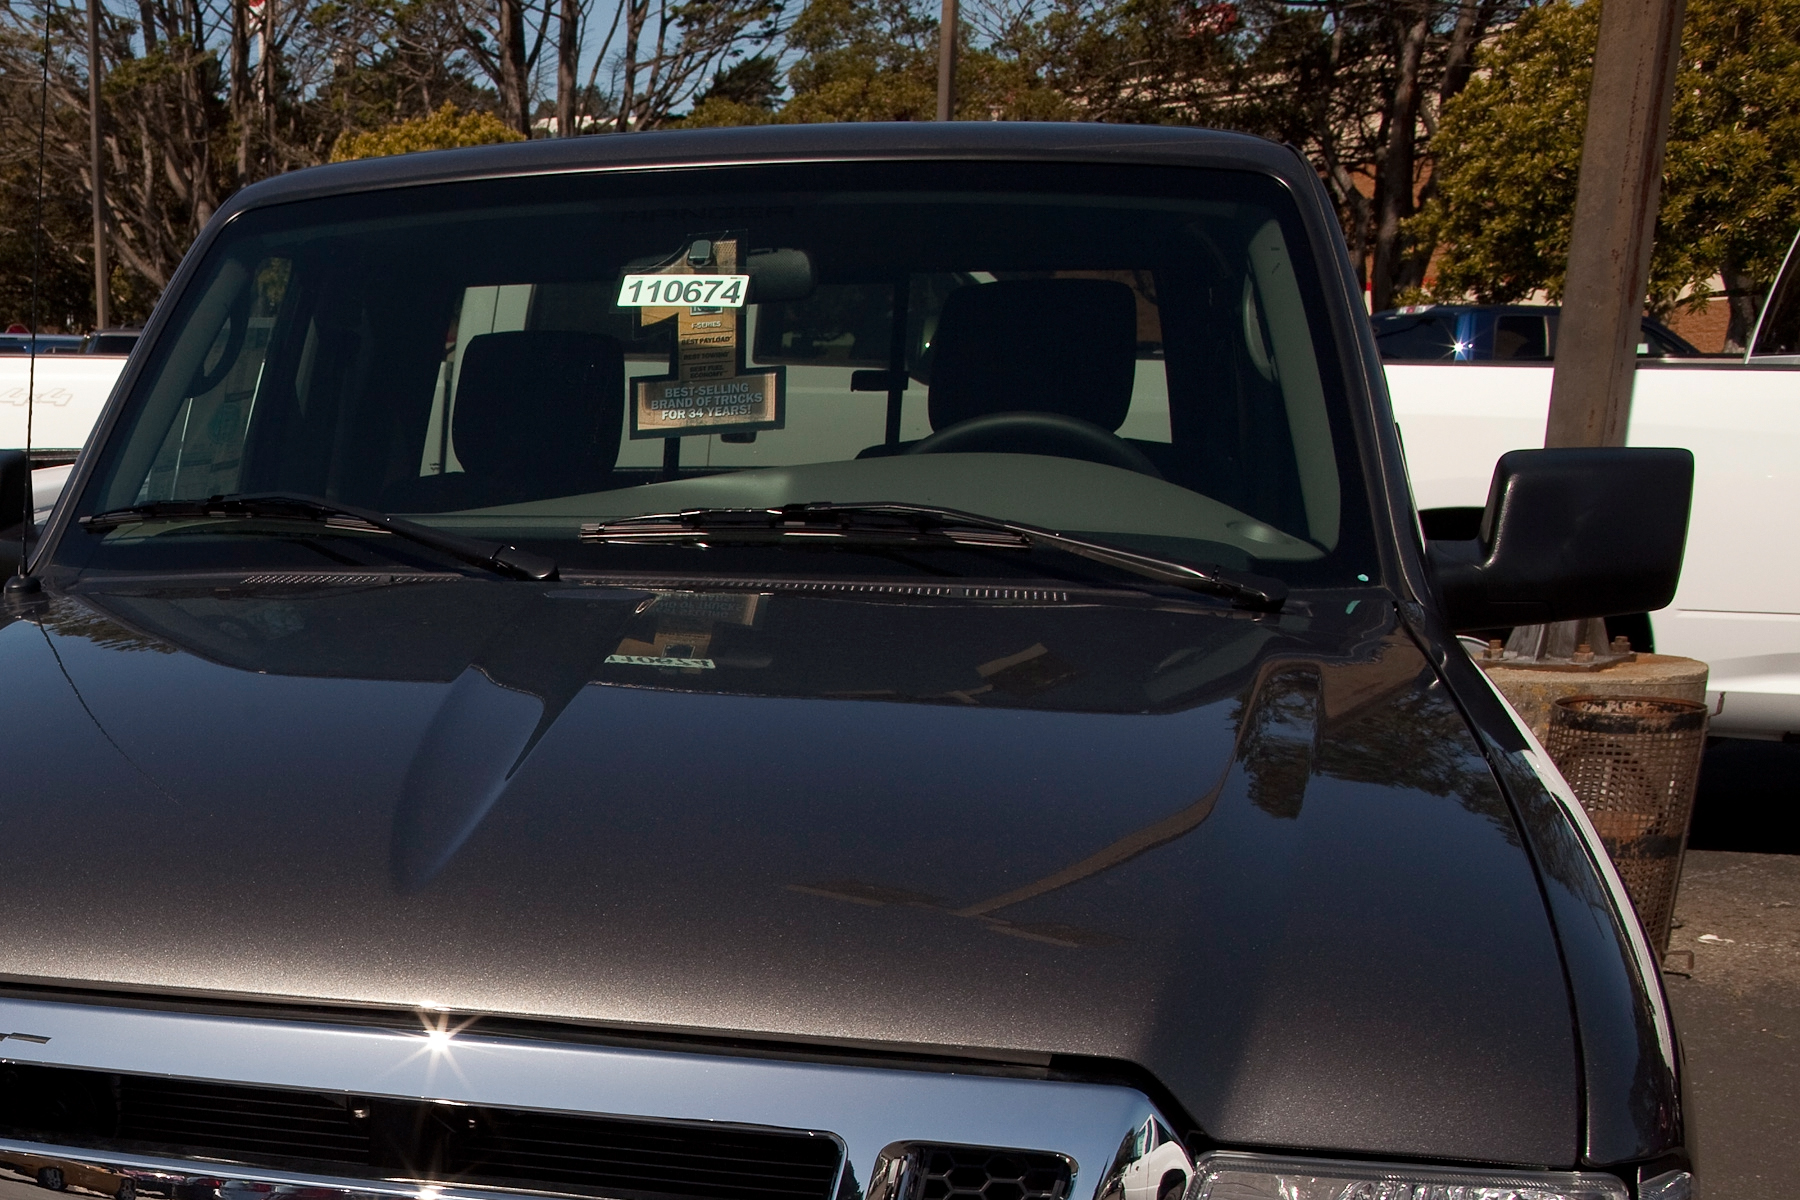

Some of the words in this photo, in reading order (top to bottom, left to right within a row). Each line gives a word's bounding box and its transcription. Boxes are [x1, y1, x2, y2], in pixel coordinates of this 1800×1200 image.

[629, 280, 741, 304] 110674
[681, 338, 698, 346] BEST
[665, 382, 749, 398] BEST-SELLING
[651, 398, 693, 410] BRAND
[696, 396, 712, 407] OF
[714, 393, 763, 405] TRUCKS
[662, 409, 686, 421] FOR
[688, 408, 704, 419] 34
[706, 405, 752, 417] YEARS!
